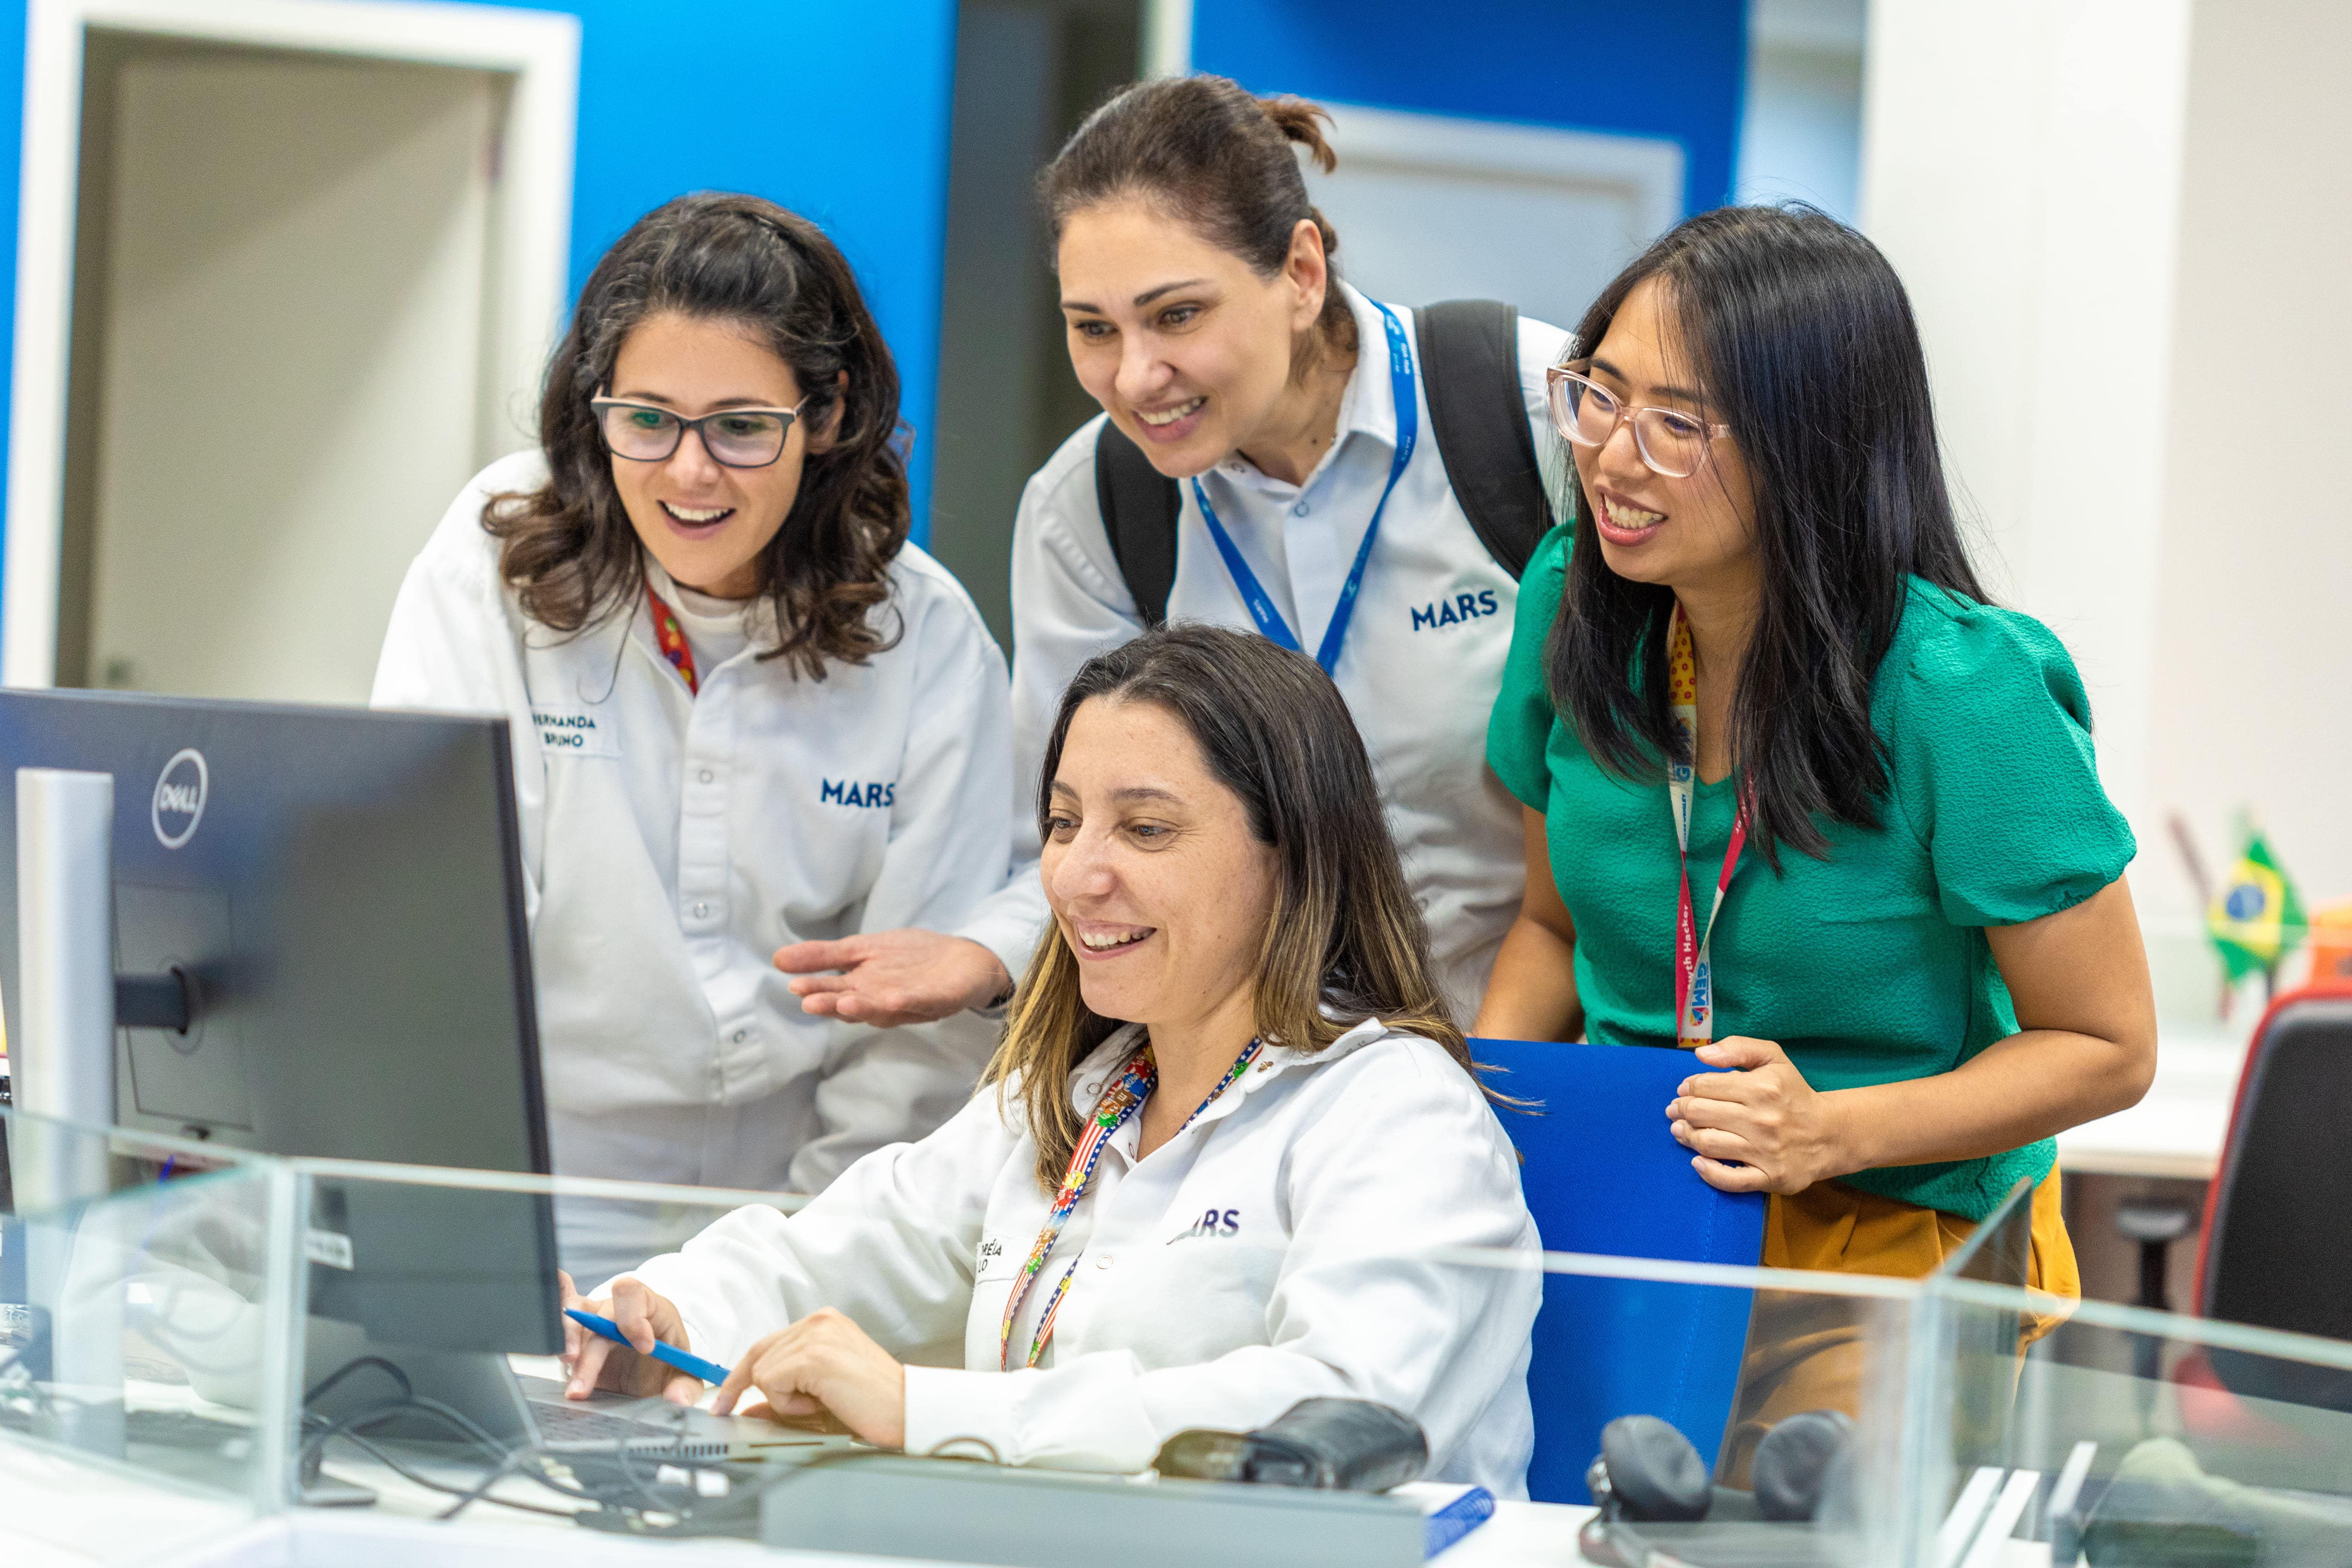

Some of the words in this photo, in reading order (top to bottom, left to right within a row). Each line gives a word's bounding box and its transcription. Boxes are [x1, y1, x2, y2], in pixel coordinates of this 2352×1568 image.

[1411, 590, 1498, 631] MARS
[159, 784, 197, 813] DELL
[821, 777, 895, 808] MARS
[1682, 904, 1692, 952] Hacker
[1691, 963, 1707, 1006] GEM
